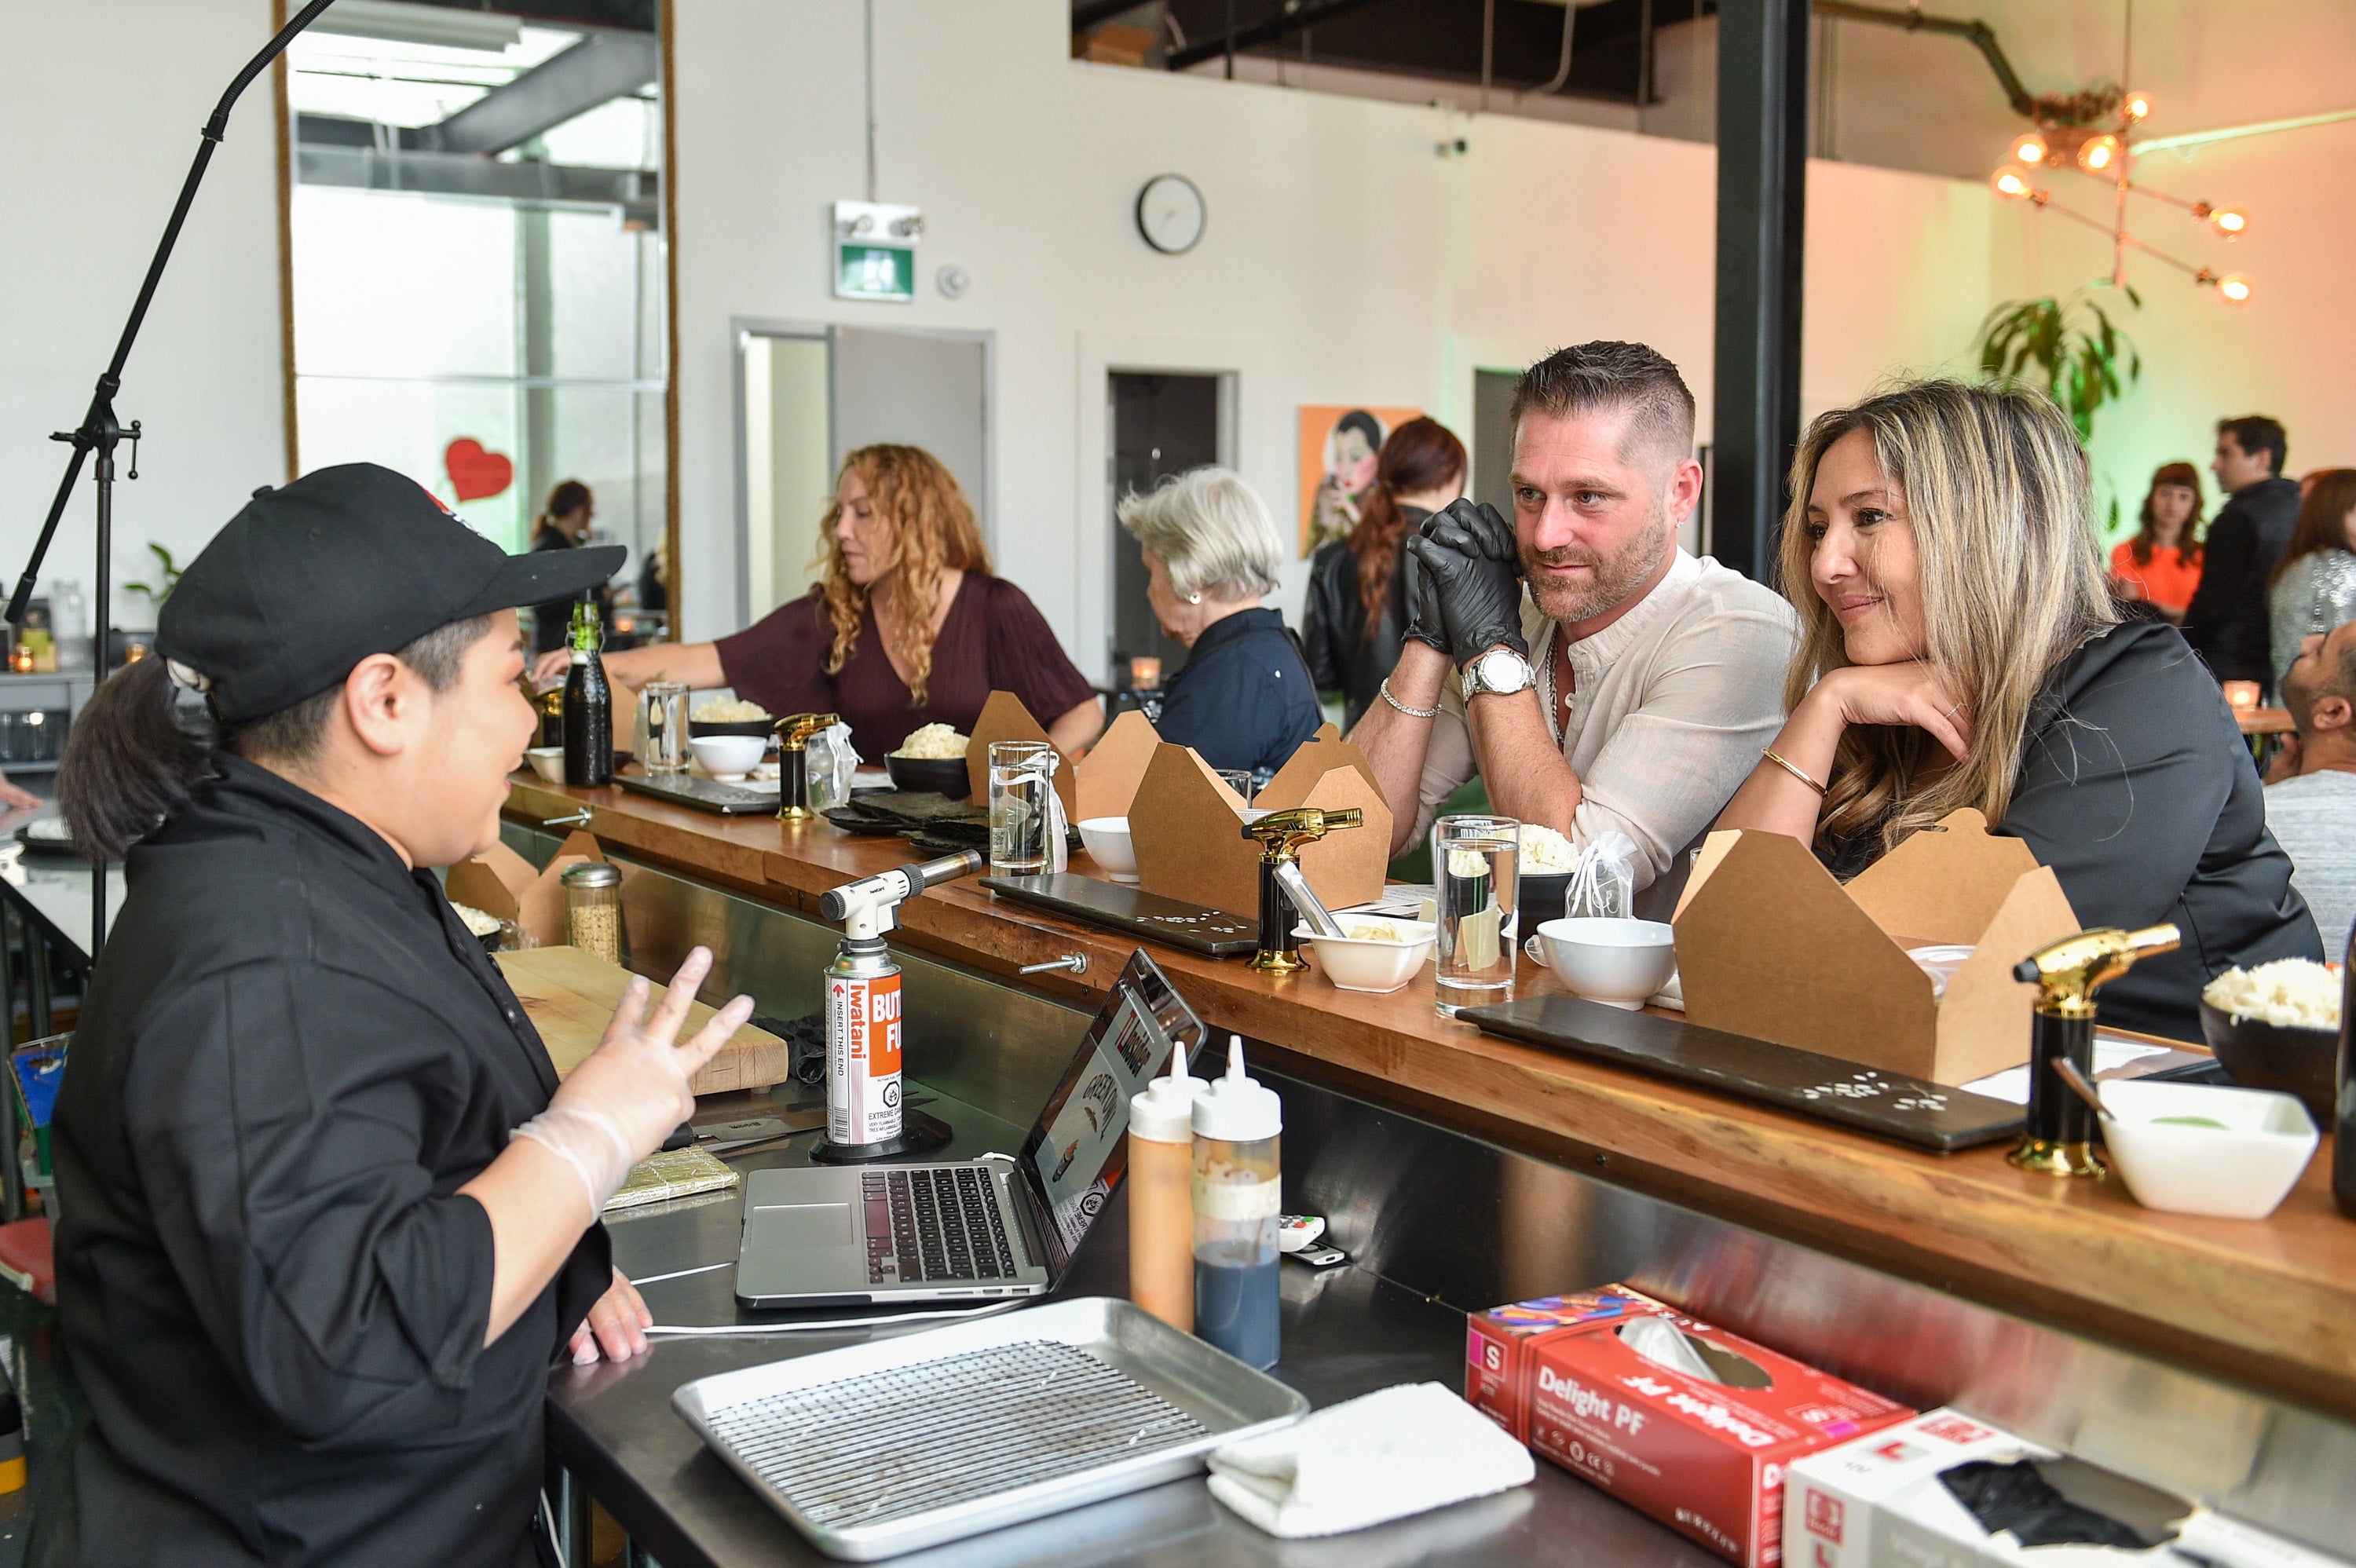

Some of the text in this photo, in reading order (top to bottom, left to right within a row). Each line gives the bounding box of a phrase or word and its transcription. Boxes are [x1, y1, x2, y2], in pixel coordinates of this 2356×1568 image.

[851, 985, 866, 1058] Iwatani
[1083, 1073, 1116, 1106] GREEN
[869, 1109, 894, 1120] EXTREME
[1486, 1345, 1501, 1370] S
[1538, 1365, 1611, 1422] Delight
[1614, 1404, 1645, 1436] PF
